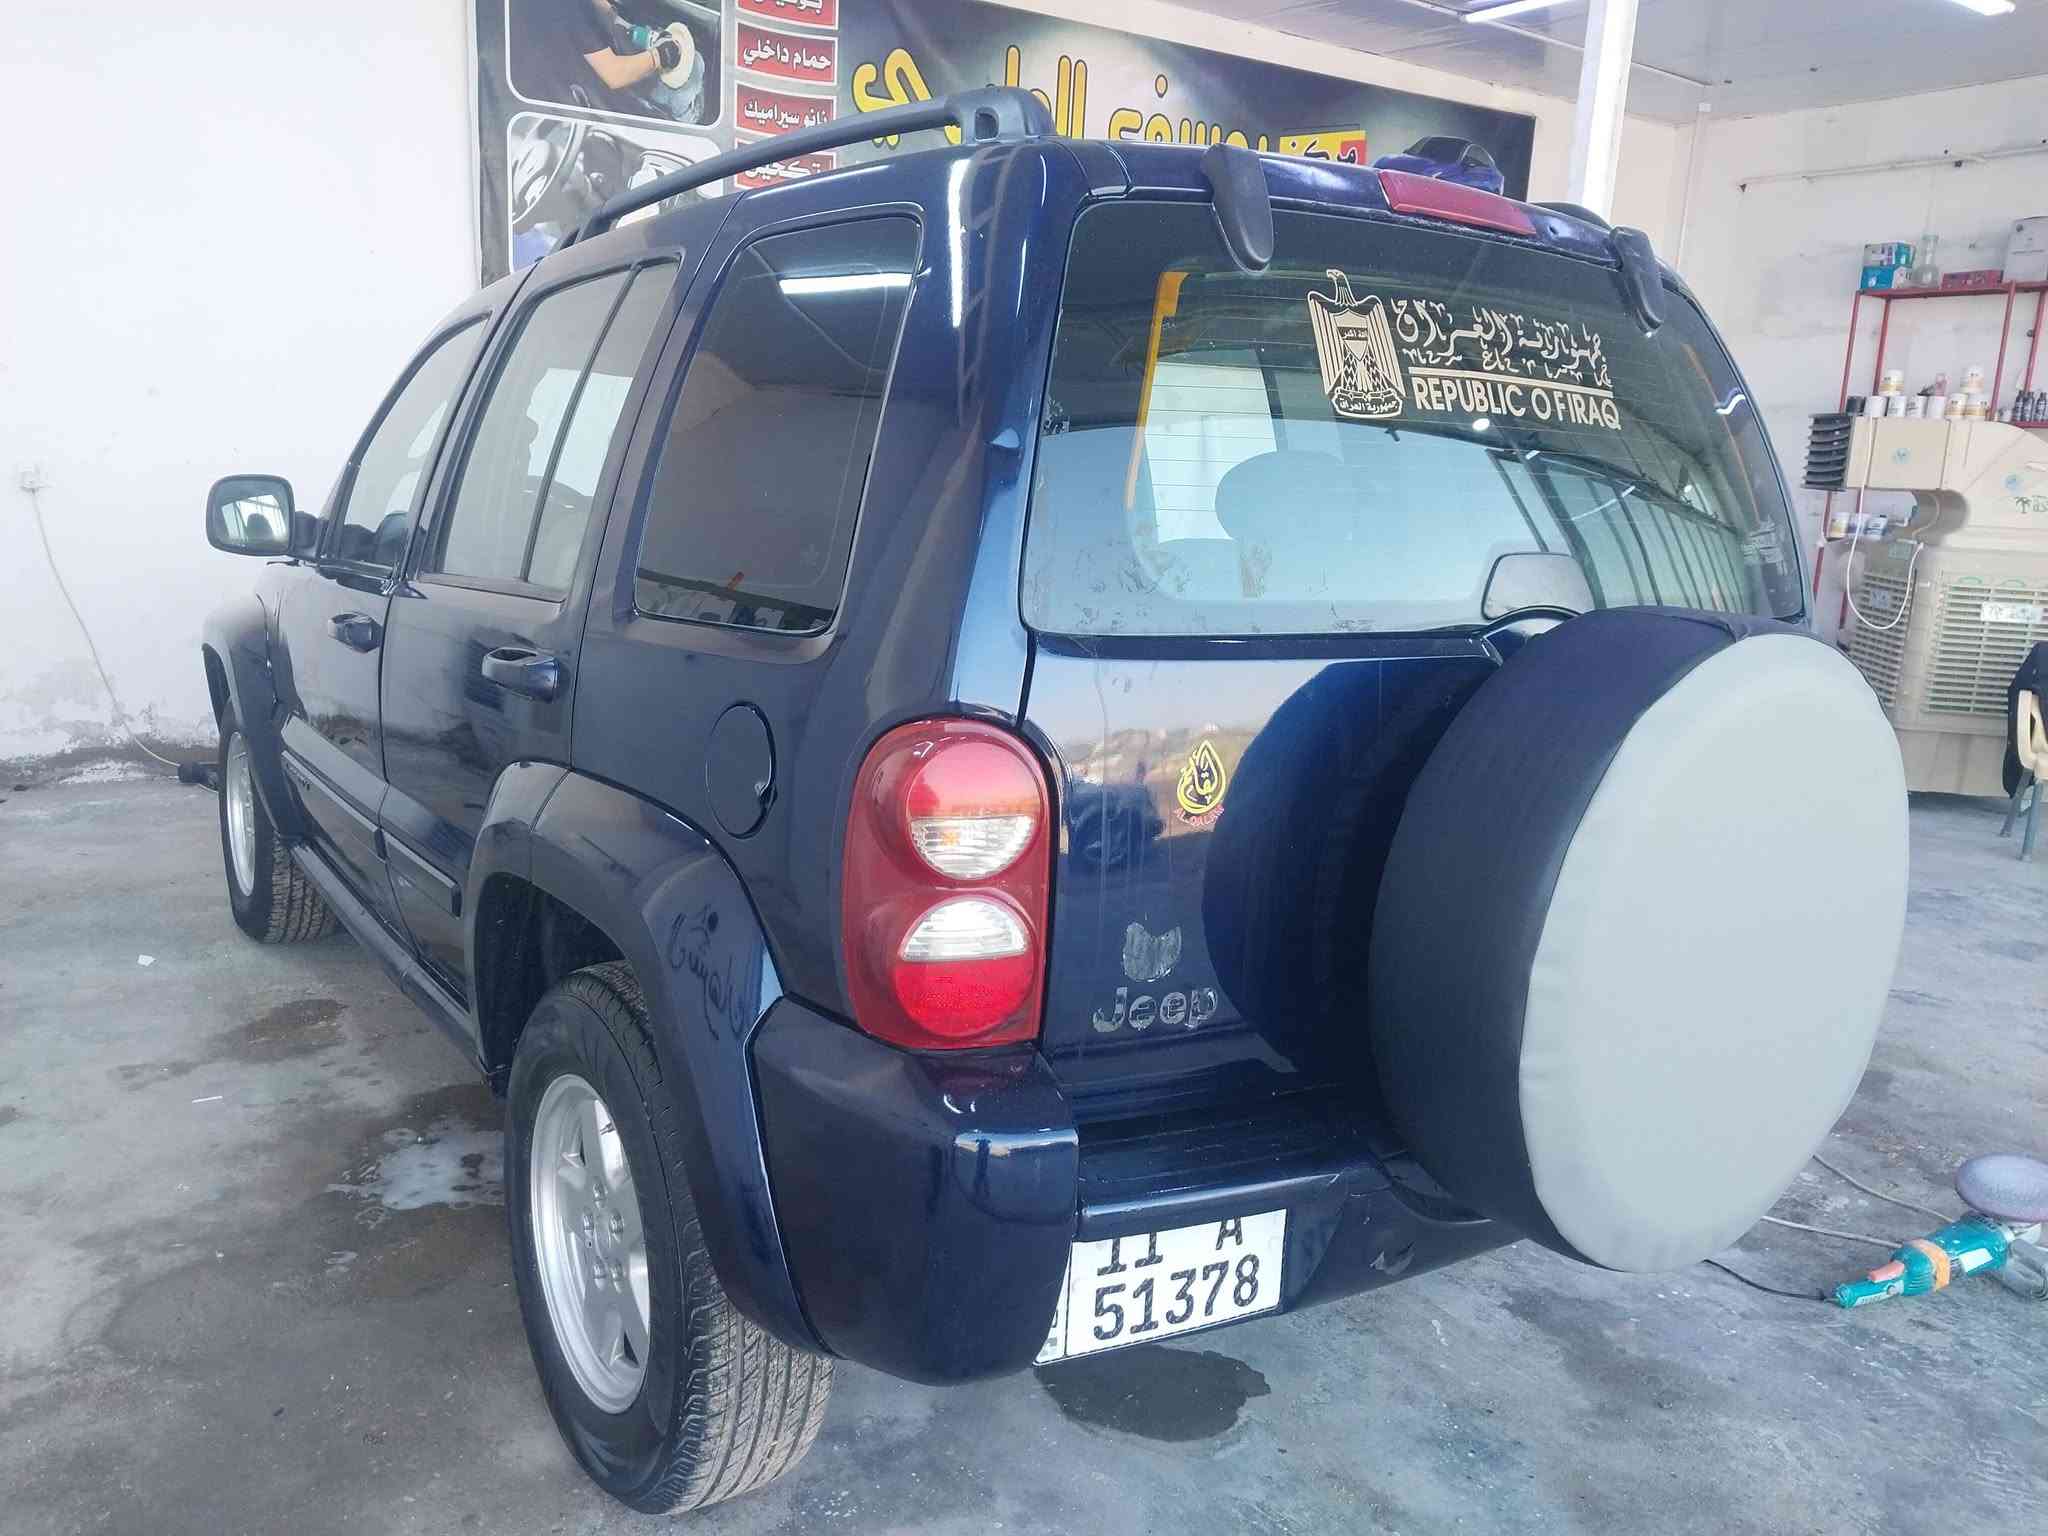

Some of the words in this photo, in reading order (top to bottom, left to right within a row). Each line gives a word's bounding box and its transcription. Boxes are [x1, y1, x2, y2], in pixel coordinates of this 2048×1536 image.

[743, 38, 790, 65] داخلي
[793, 49, 832, 72] حمام
[744, 100, 800, 128] سيراميك
[1411, 376, 1527, 417] REPUBLIC
[1567, 393, 1622, 431] IRAQ
[1092, 987, 1218, 1032] Jeep
[1093, 1254, 1260, 1340] 51378
